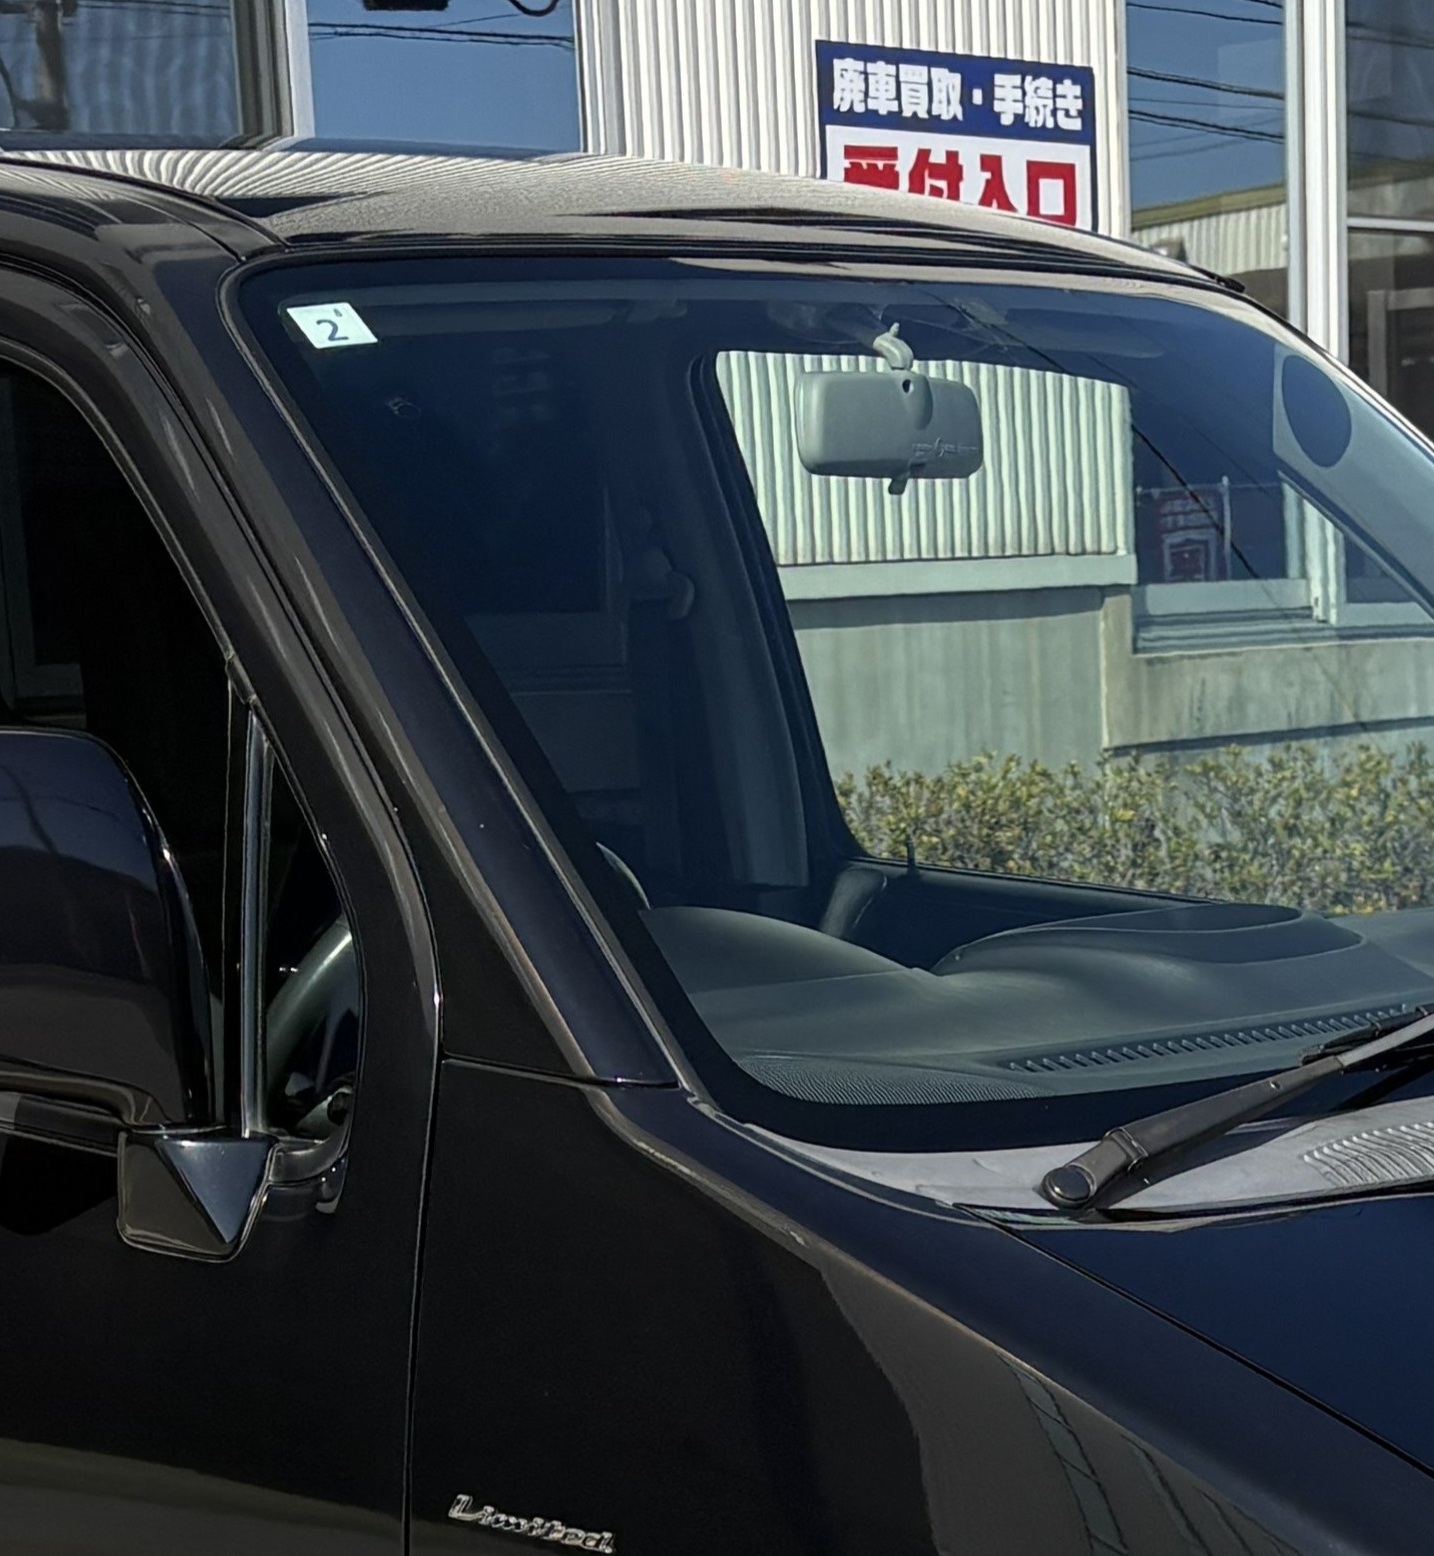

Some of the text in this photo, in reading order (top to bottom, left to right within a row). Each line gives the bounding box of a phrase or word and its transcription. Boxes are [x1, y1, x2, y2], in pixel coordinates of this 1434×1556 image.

[833, 57, 1083, 131] 廃車買取・手続き
[843, 144, 1077, 228] 受付入口
[316, 319, 349, 342] 2
[447, 1493, 617, 1555] Limited
